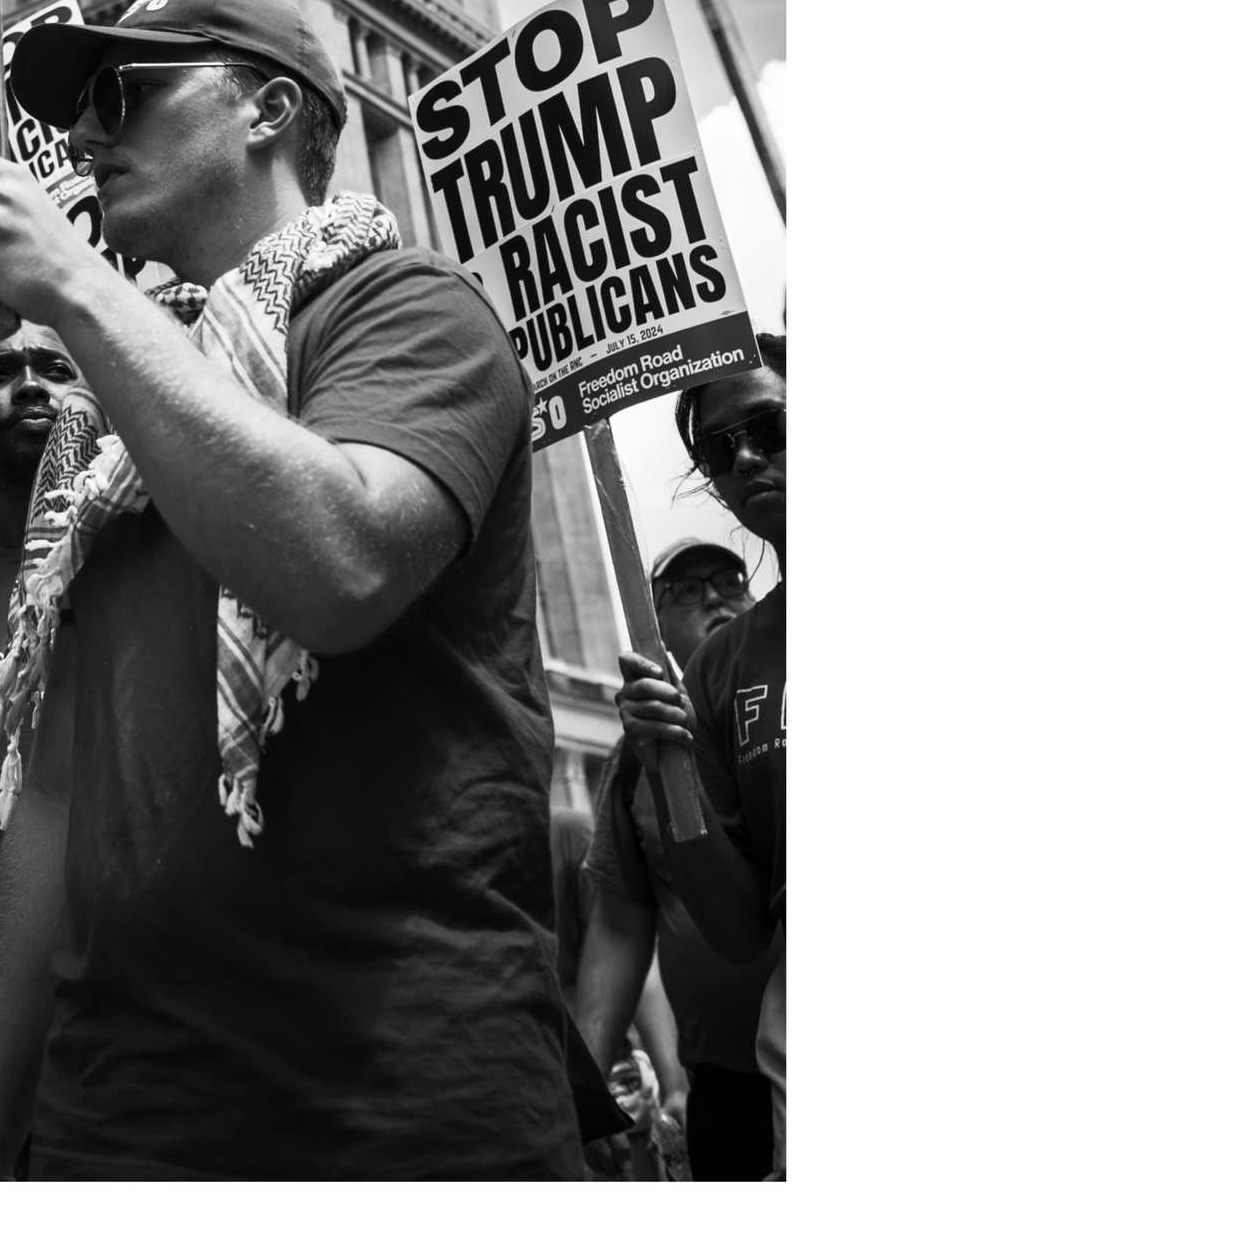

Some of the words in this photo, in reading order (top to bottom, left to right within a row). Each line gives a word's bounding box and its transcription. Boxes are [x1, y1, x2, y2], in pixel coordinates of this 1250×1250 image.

[430, 56, 678, 264] TRUMP
[498, 155, 707, 323] RACIST
[509, 244, 727, 373] PUBLICANS
[532, 375, 549, 390] ARCH
[548, 371, 557, 384] ON
[556, 366, 569, 380] THE
[569, 356, 584, 374] RNC
[605, 338, 625, 354] JULY
[626, 335, 640, 347] 15,
[640, 325, 664, 341] 2024
[578, 362, 639, 398] Freedom
[639, 344, 684, 372] Road
[582, 378, 639, 414] Socialist
[639, 348, 745, 390] Organization
